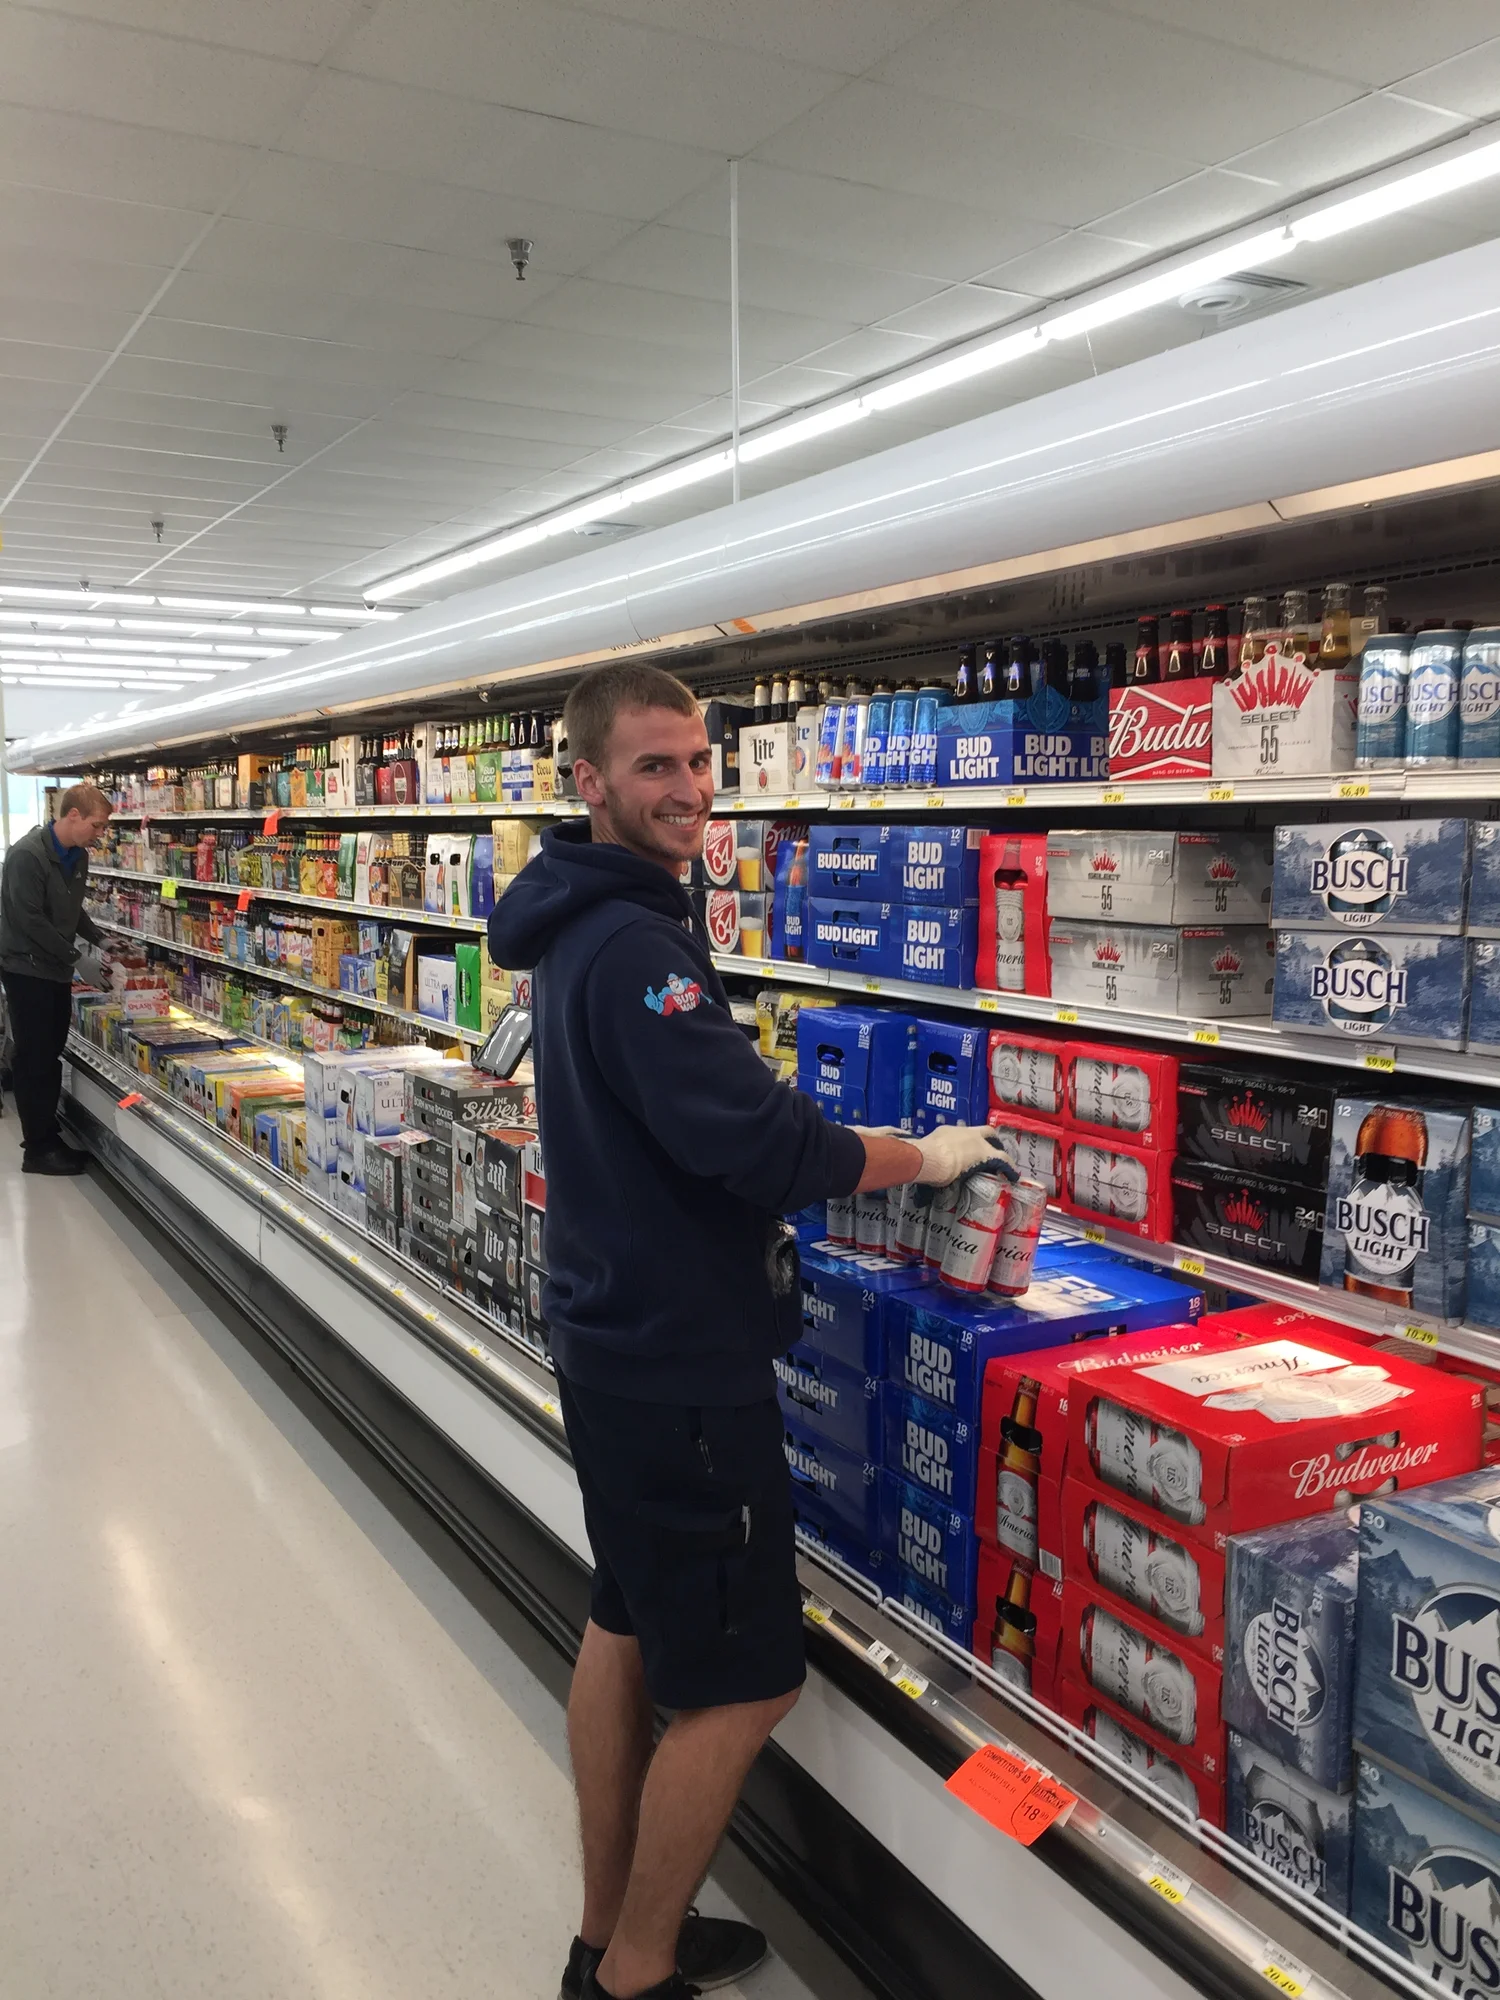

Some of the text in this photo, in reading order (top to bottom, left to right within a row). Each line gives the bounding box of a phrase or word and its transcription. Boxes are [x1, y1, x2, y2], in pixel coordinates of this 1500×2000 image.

[1241, 710, 1300, 725] SELECT
[752, 737, 775, 767] Lite
[886, 735, 909, 750] UD
[956, 736, 992, 759] BUD
[1025, 734, 1072, 756] BUD
[1260, 724, 1279, 765] 55
[950, 757, 999, 780] LIGHT
[1013, 755, 1078, 777] LIGHT
[1080, 757, 1109, 777] LIG
[1209, 791, 1231, 801] $7.49
[1339, 787, 1365, 797] $6.49
[707, 825, 731, 845] Miller
[881, 826, 890, 837] 12
[951, 828, 961, 839] 12
[1278, 831, 1291, 842] 12
[1477, 827, 1495, 840] 12
[712, 839, 731, 874] 64
[817, 853, 878, 872] BUD LIGHT
[908, 841, 942, 864] BUD
[1148, 849, 1164, 860] 24
[903, 865, 944, 890] LIGHT
[1087, 872, 1121, 882] SELECT
[1204, 880, 1240, 888] SELECT
[1311, 858, 1408, 894] BUSCH
[881, 903, 890, 913] 12
[1101, 885, 1112, 911] 55
[1215, 887, 1228, 912] 55
[786, 915, 800, 926] BUD
[949, 909, 959, 920] 12
[1343, 913, 1373, 924] LIGHT
[716, 909, 734, 942] 64
[785, 925, 802, 935] LIGHT
[907, 919, 941, 944] BUD
[817, 925, 879, 947] BUD LIGHT
[1278, 934, 1292, 946] 12
[903, 945, 945, 970] LIGHT
[1152, 942, 1168, 954] 24
[1476, 944, 1493, 957] 12
[1091, 961, 1125, 972] SELECT
[1208, 972, 1245, 981] SELECT
[1105, 975, 1117, 1001] 55
[1219, 980, 1232, 1005] 55
[1311, 966, 1407, 1006] BUSCH
[673, 991, 695, 1005] BUD
[759, 1002, 772, 1011] 24
[859, 1024, 869, 1035] 20
[1343, 1021, 1373, 1033] LIGHT
[962, 1033, 972, 1043] 12
[820, 1064, 840, 1080] BUD
[816, 1080, 842, 1098] LIGHT
[930, 1077, 953, 1095] BUD
[462, 1100, 520, 1121] Silver
[494, 1097, 508, 1105] THE
[926, 1092, 956, 1111] LIGHT
[1337, 1105, 1351, 1117] 12
[434, 1105, 453, 1120] ROCKIES
[1297, 1104, 1318, 1120] 24
[1475, 1114, 1491, 1127] 18
[1211, 1127, 1291, 1153] SELECT
[1294, 1206, 1315, 1221] 24
[1338, 1200, 1429, 1251] BUSCH
[1472, 1224, 1486, 1238] 18
[483, 1226, 505, 1263] Lite
[948, 1229, 980, 1256] rica
[1206, 1222, 1286, 1253] SELECT
[1353, 1237, 1407, 1262] LIGHT
[862, 1288, 875, 1304] 24
[1189, 1296, 1201, 1310] 18
[802, 1293, 836, 1322] IGHT
[962, 1330, 973, 1345] 18
[1405, 1327, 1434, 1345] 10.49
[909, 1331, 952, 1375] BUD
[1056, 1340, 1204, 1374] Budweiser
[797, 1368, 838, 1409] LIGHT
[864, 1376, 877, 1392] 24
[904, 1354, 956, 1405] LIGHT
[956, 1421, 969, 1438] 18
[906, 1418, 949, 1465] BUD
[798, 1451, 838, 1492] LIGHT
[862, 1462, 875, 1479] 24
[902, 1442, 953, 1496] LIGHT
[1289, 1441, 1440, 1500] Budweiser
[949, 1513, 962, 1530] 18
[1362, 1510, 1385, 1530] 30
[901, 1506, 942, 1556] BUD
[898, 1531, 948, 1590] LIGHT
[951, 1604, 963, 1621] 18
[1256, 1620, 1270, 1696] LIGHT
[1268, 1598, 1301, 1735] BUSCH
[1394, 1616, 1500, 1724] BUS
[1432, 1706, 1500, 1760] LIG
[1360, 1760, 1380, 1782] 30
[1244, 1810, 1327, 1891] BUSCH
[1391, 1870, 1500, 1989] BUS
[1263, 1966, 1297, 1992] 20.49
